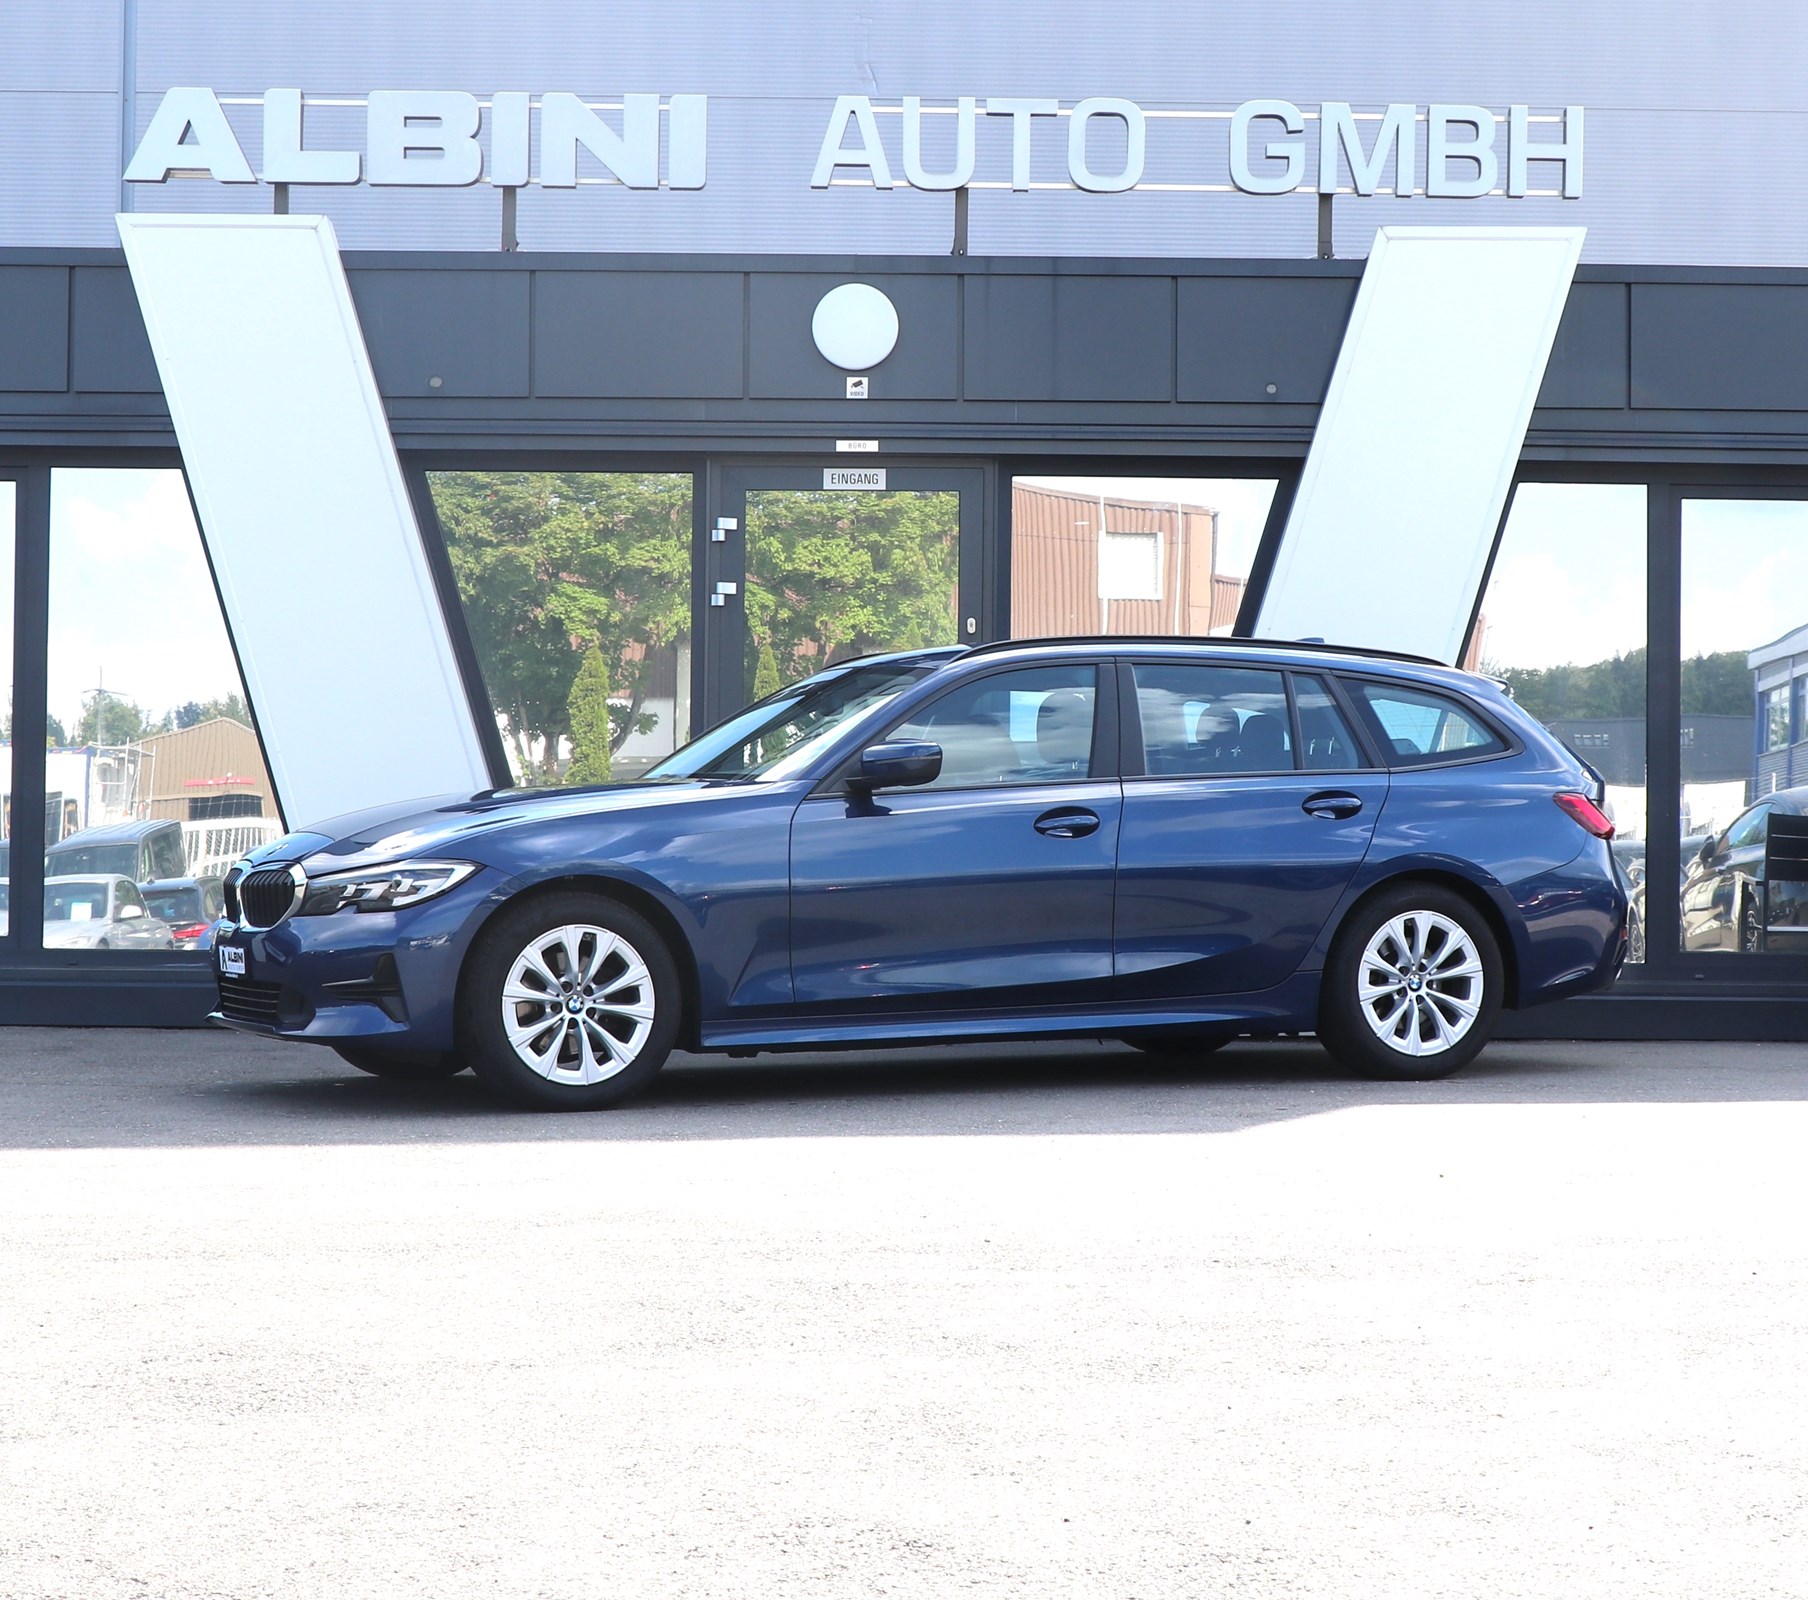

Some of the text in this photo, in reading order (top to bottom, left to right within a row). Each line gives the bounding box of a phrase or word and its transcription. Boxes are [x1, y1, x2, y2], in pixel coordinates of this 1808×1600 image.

[123, 87, 1584, 199] ALBINI AUTO GMBH
[848, 441, 867, 449] BÜRO
[831, 473, 879, 485] EINGANG
